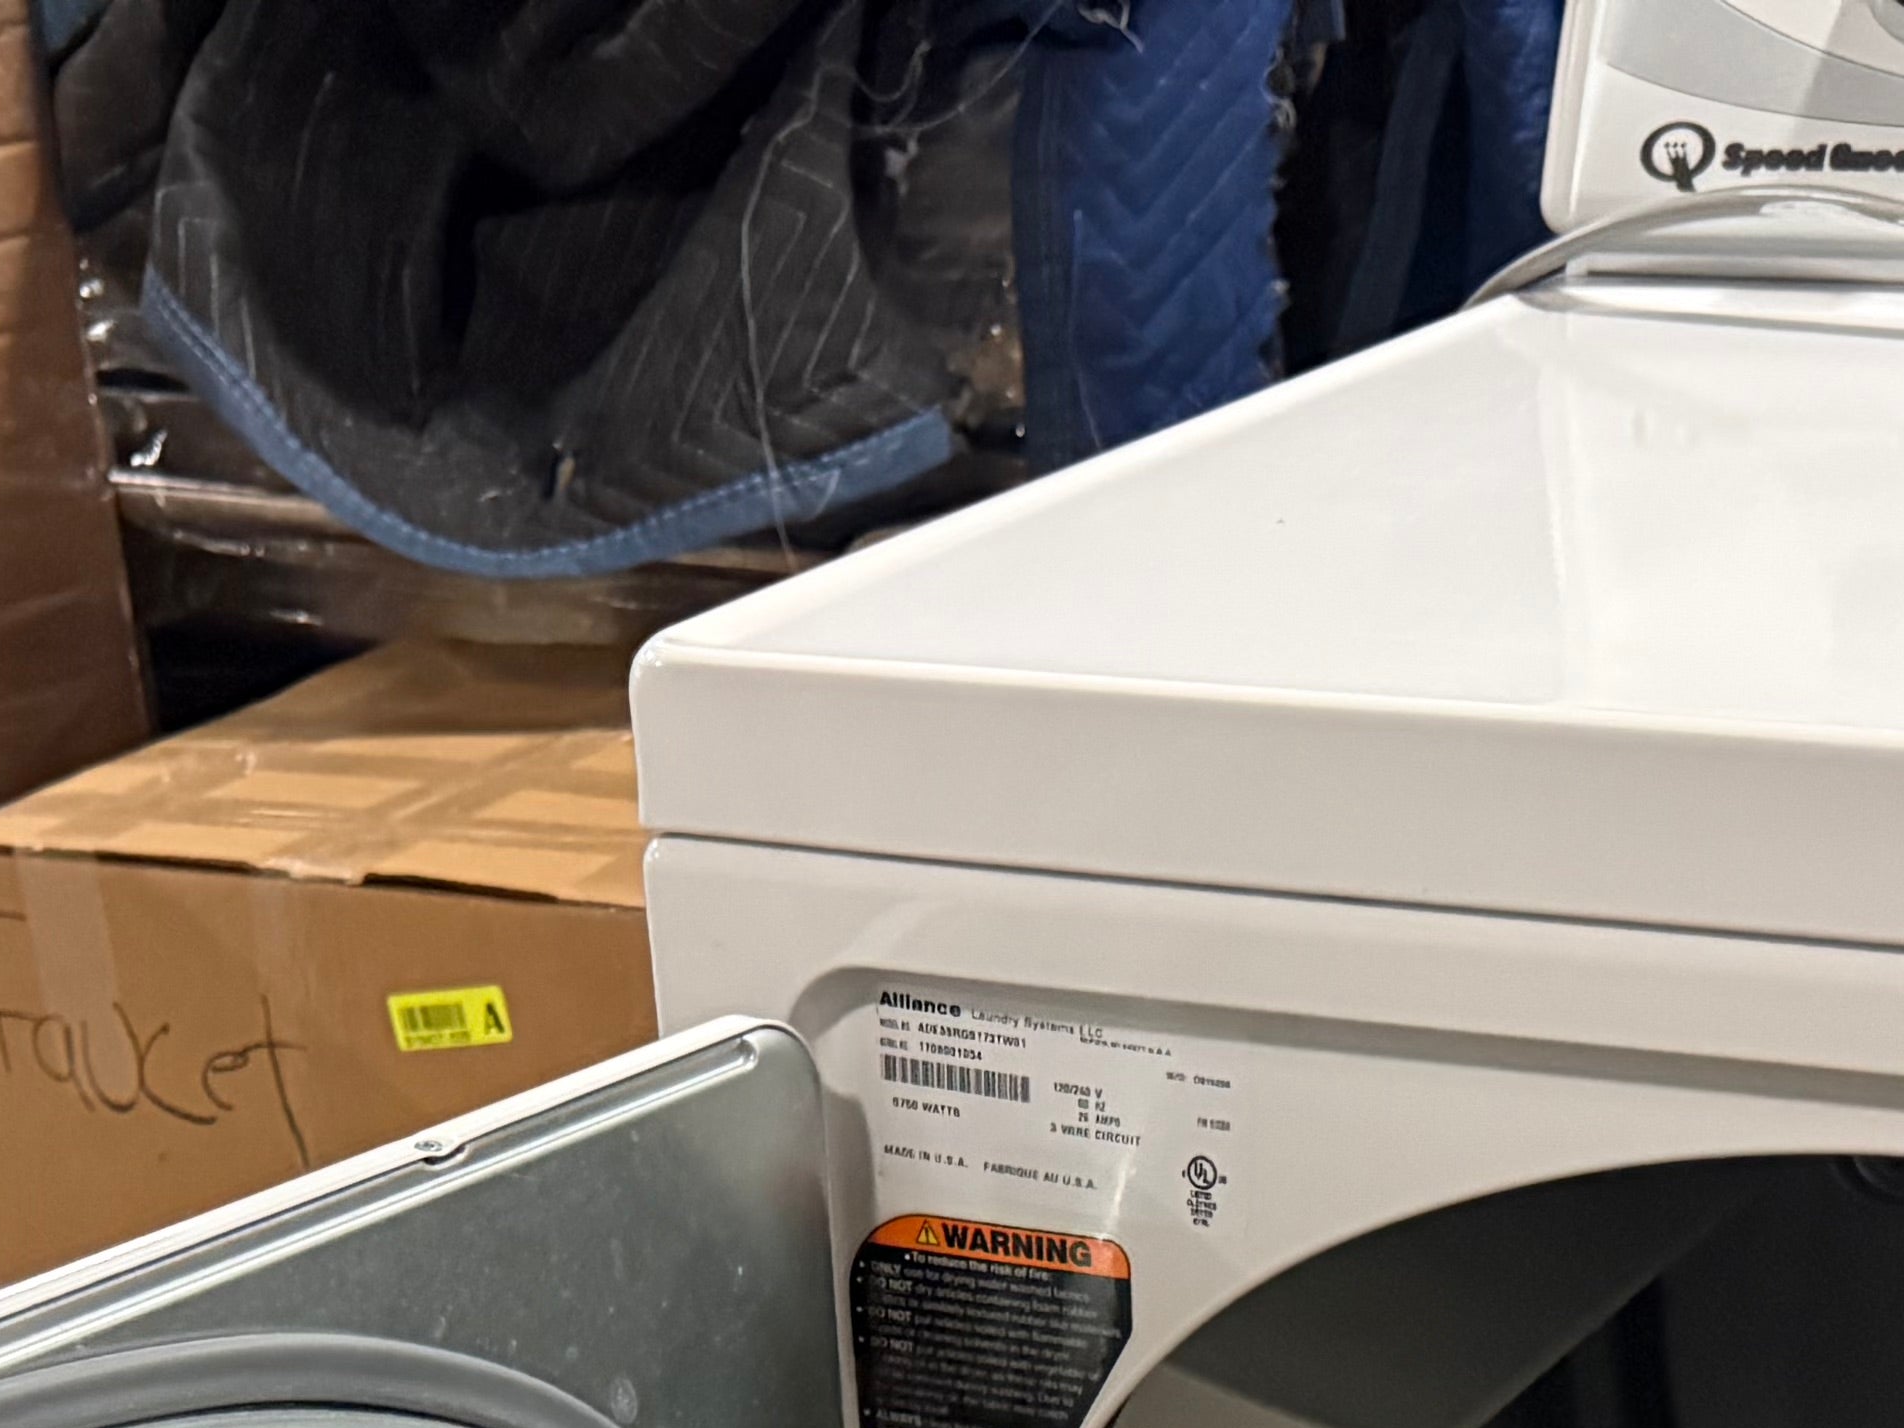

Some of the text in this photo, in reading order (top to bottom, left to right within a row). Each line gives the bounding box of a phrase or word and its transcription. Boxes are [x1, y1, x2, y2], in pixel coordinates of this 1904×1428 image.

[1722, 143, 1827, 176] Speed
[879, 991, 961, 1017] Alliance
[484, 1002, 505, 1035] A
[922, 1102, 960, 1118] WATTS
[1095, 1130, 1142, 1147] CIRCUIT
[884, 1144, 916, 1160] MADE
[918, 1150, 931, 1161] IN
[1043, 1172, 1059, 1185] AU
[942, 1223, 1091, 1267] WARNING
[888, 1278, 912, 1293] NOT
